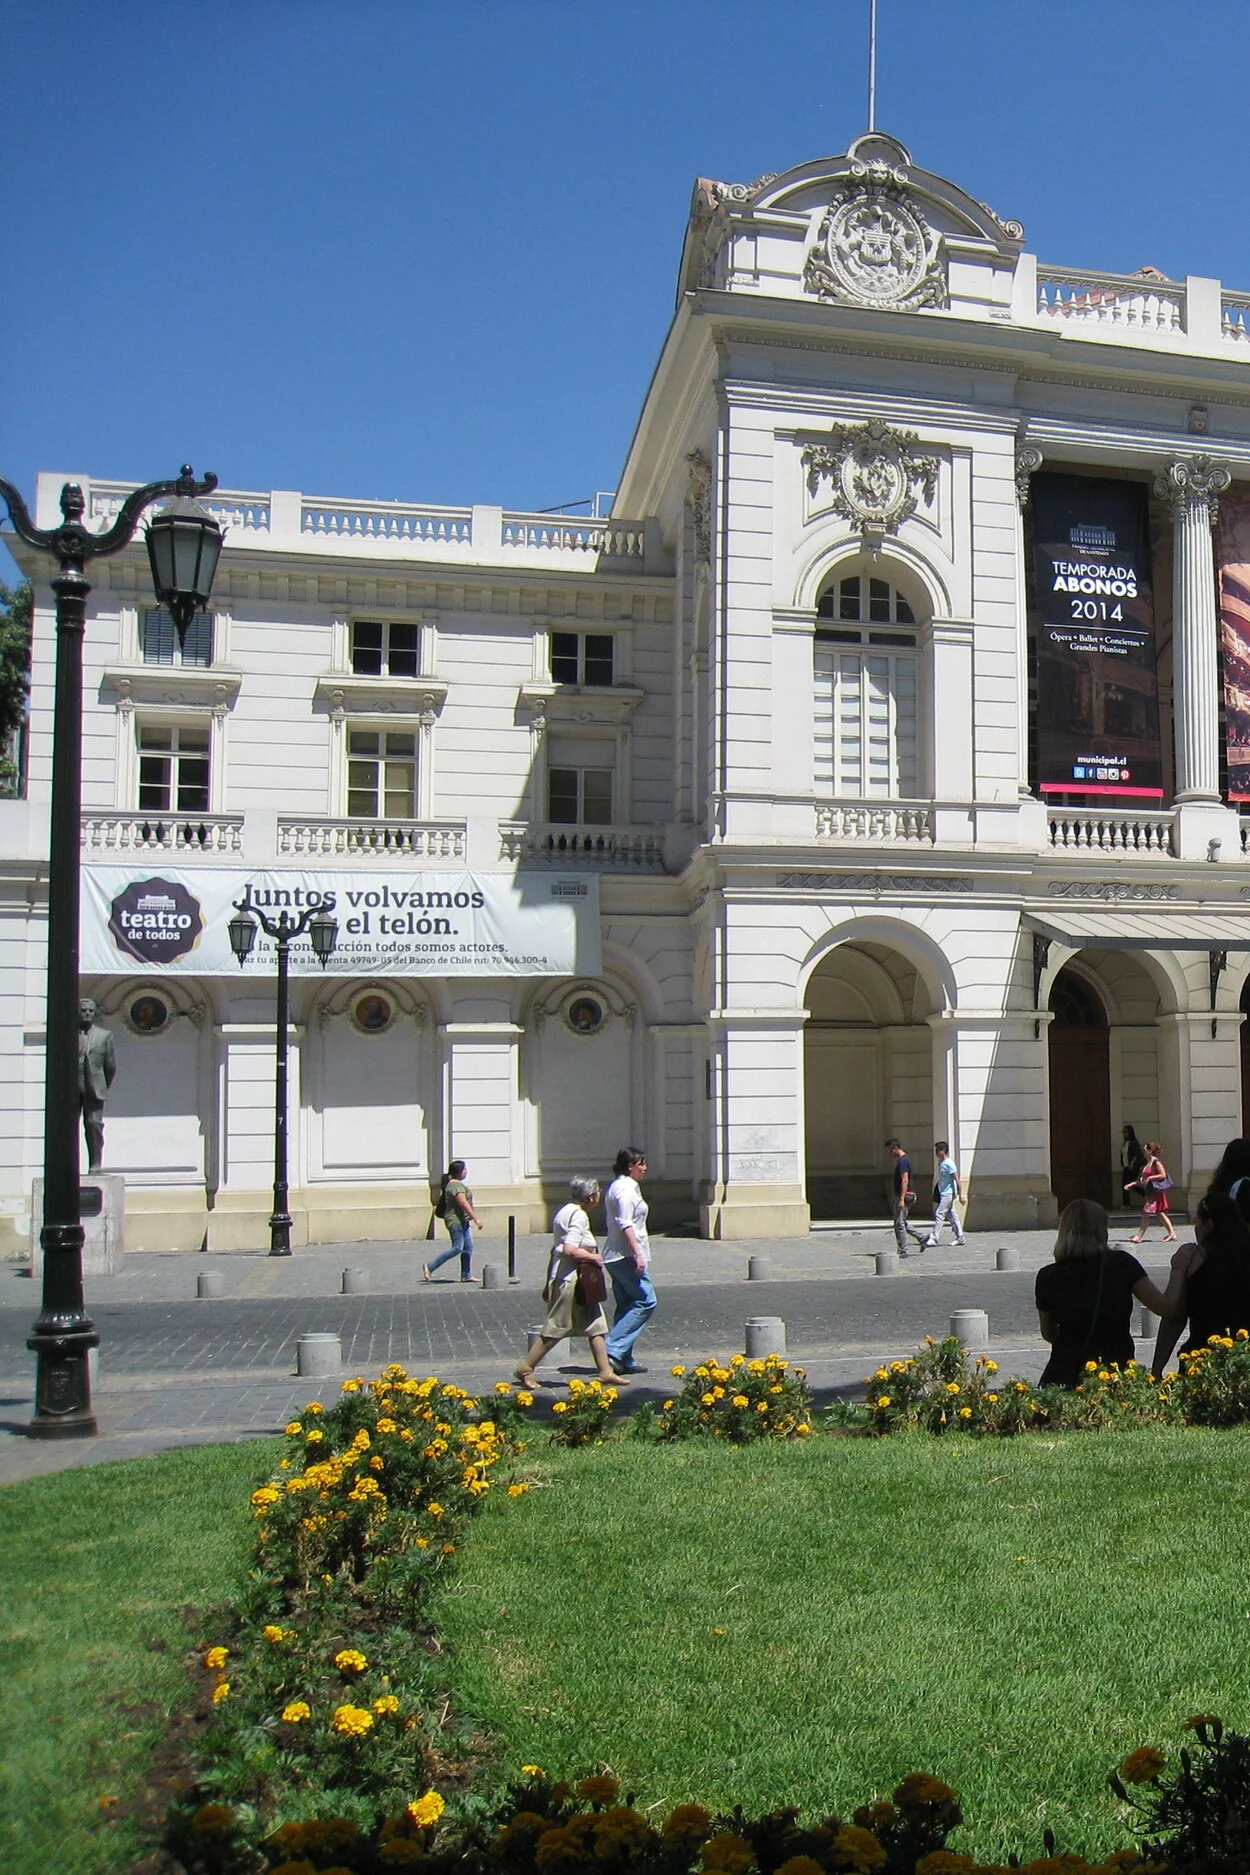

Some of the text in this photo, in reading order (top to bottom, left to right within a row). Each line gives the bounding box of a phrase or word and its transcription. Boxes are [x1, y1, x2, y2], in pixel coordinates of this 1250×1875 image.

[1052, 561, 1137, 581] TEMPORADA
[1053, 576, 1138, 598] ABONOS
[1071, 600, 1124, 621] 2014
[1050, 631, 1140, 647] Ópera Ballet Conciertos
[1069, 642, 1128, 655] Grandes Pianistas
[1077, 755, 1127, 766] municipal.cl
[243, 884, 485, 909] Juntos volvamos
[121, 910, 192, 929] teatro
[346, 911, 371, 935] el
[379, 910, 459, 936] telón.
[128, 929, 181, 940] de todos
[258, 941, 271, 952] la
[376, 941, 412, 952] todos
[415, 943, 456, 953] somos
[459, 942, 509, 952] actores.
[307, 956, 316, 964] la
[393, 956, 407, 964] del
[409, 957, 435, 965] Banco
